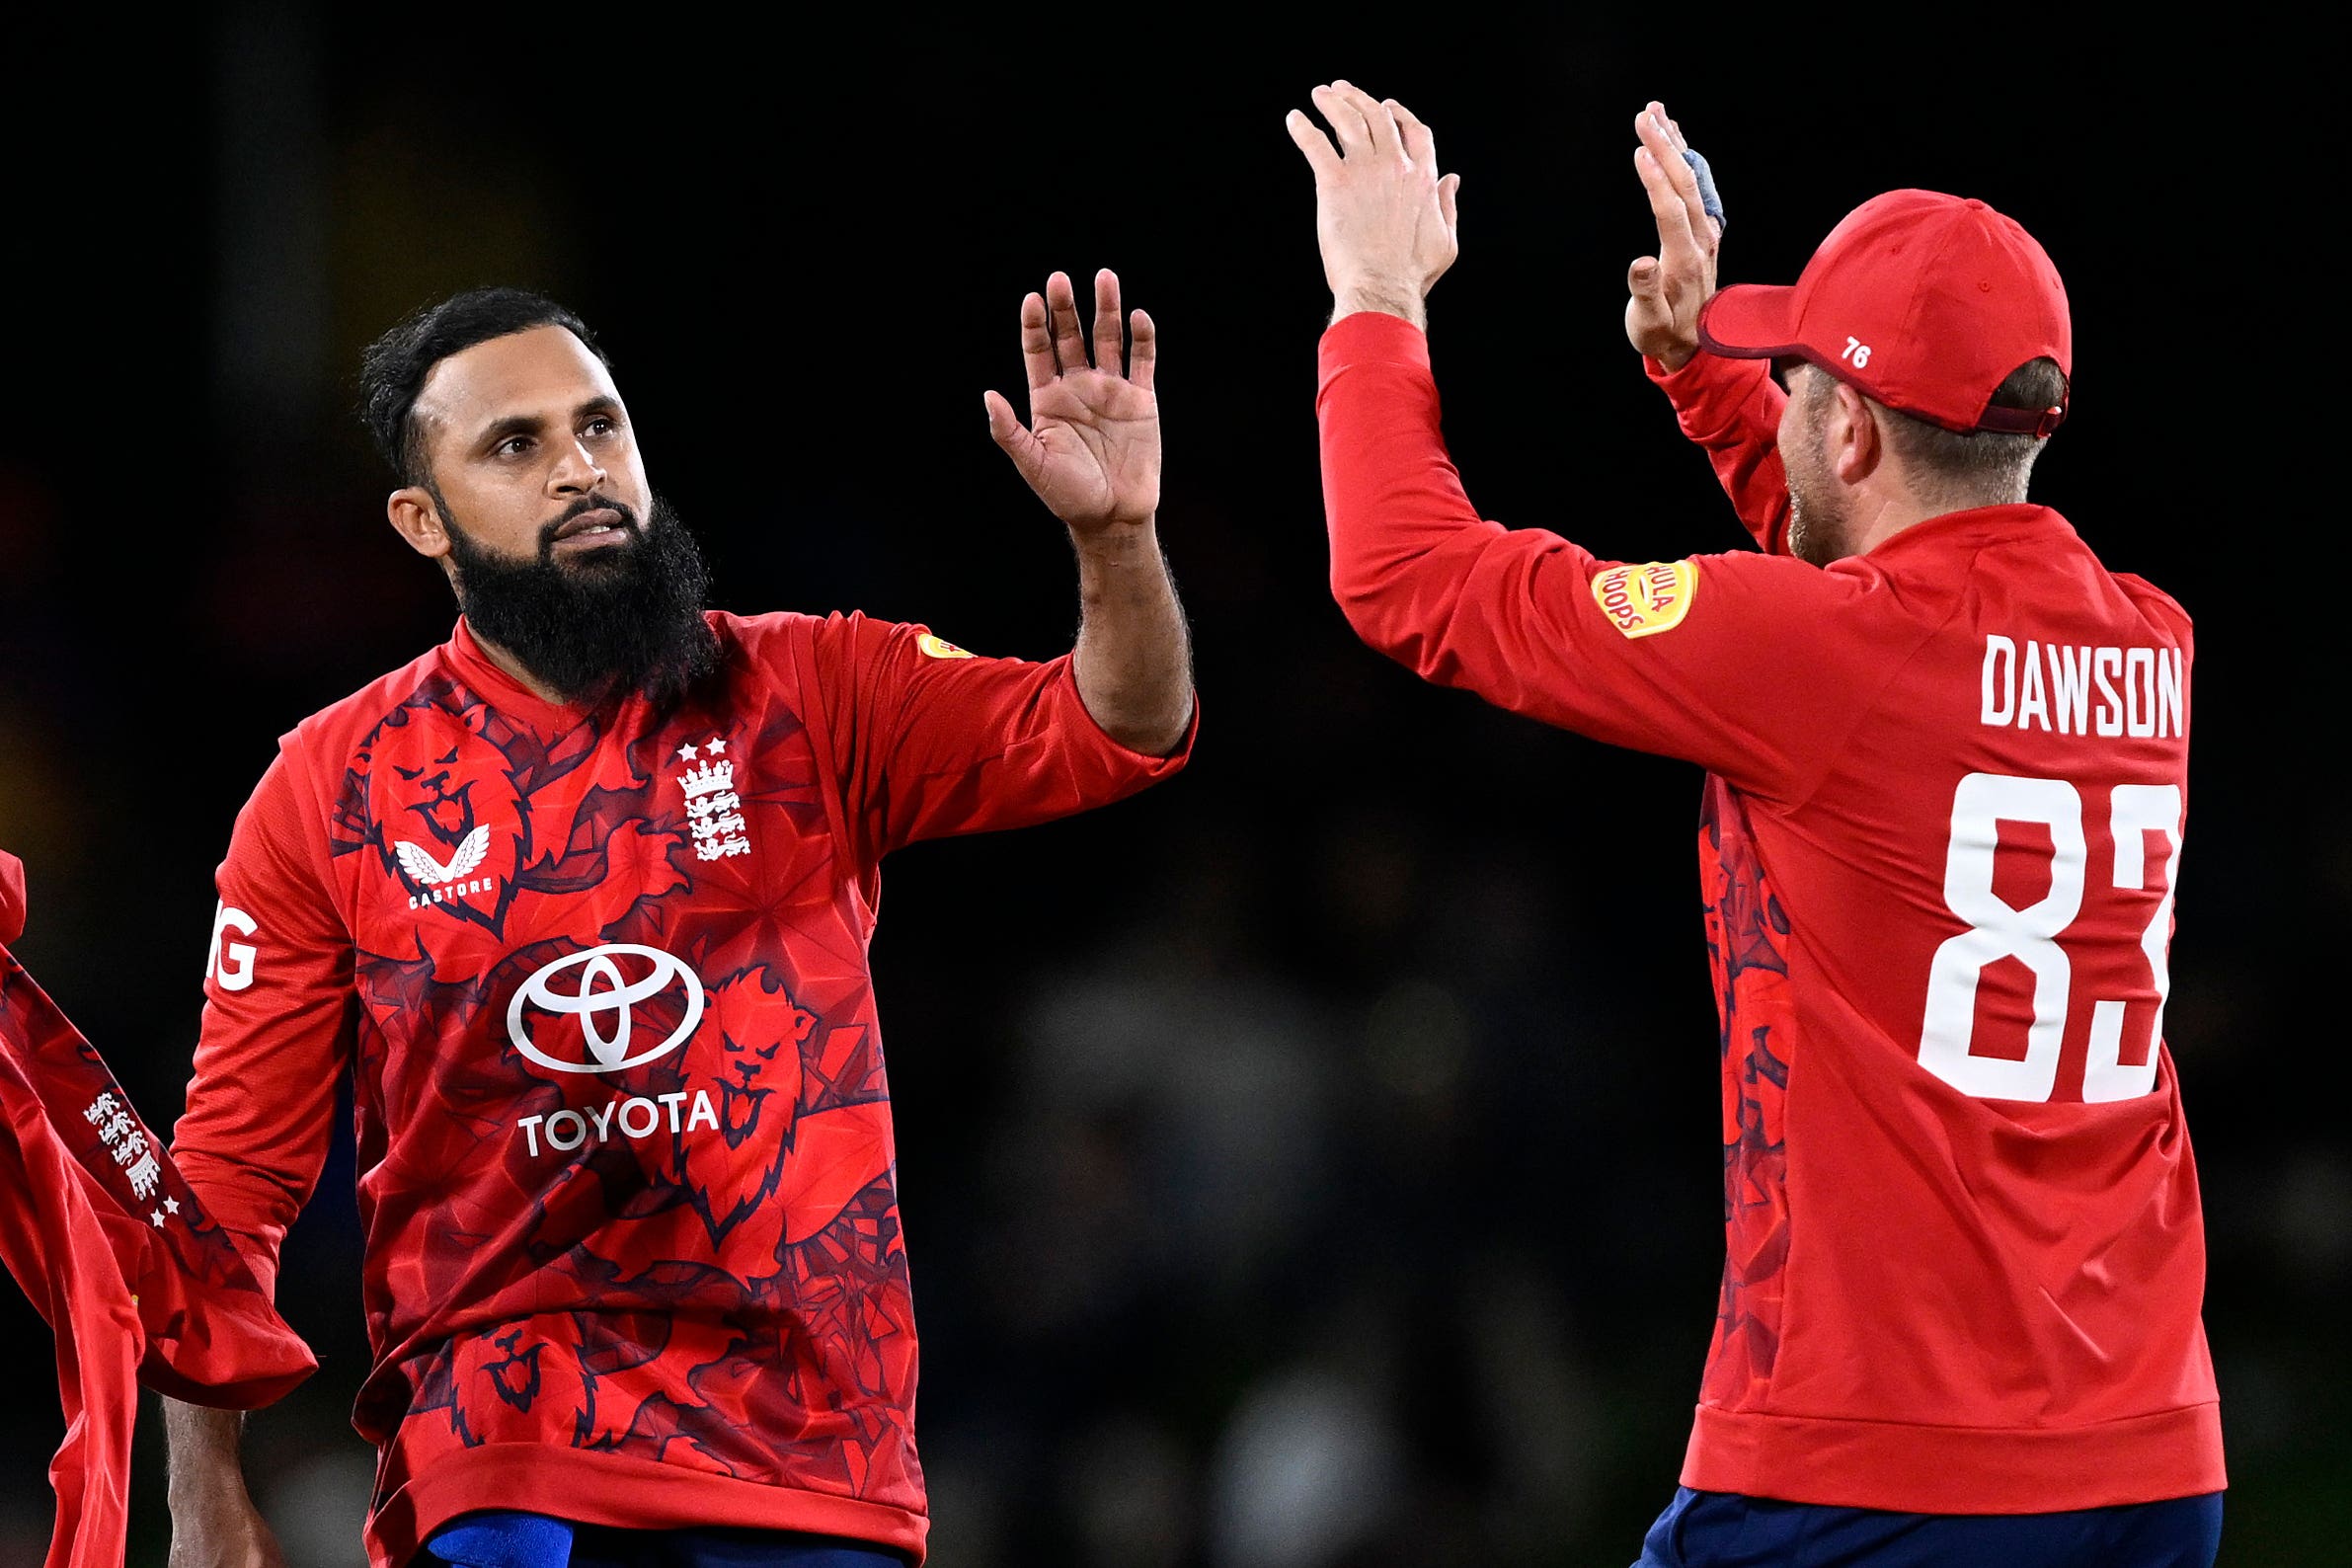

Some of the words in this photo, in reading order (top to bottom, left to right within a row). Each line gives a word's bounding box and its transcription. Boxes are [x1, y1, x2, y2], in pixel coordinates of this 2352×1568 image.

[1842, 336, 1871, 368] 76
[1602, 569, 1643, 629] HOOPS
[1645, 565, 1676, 612] HULA
[1981, 634, 2182, 738] DAWSON
[409, 878, 492, 909] CASTORE
[205, 898, 258, 990] G
[1918, 772, 2182, 1104] 83
[518, 1089, 719, 1156] TOYOTA
